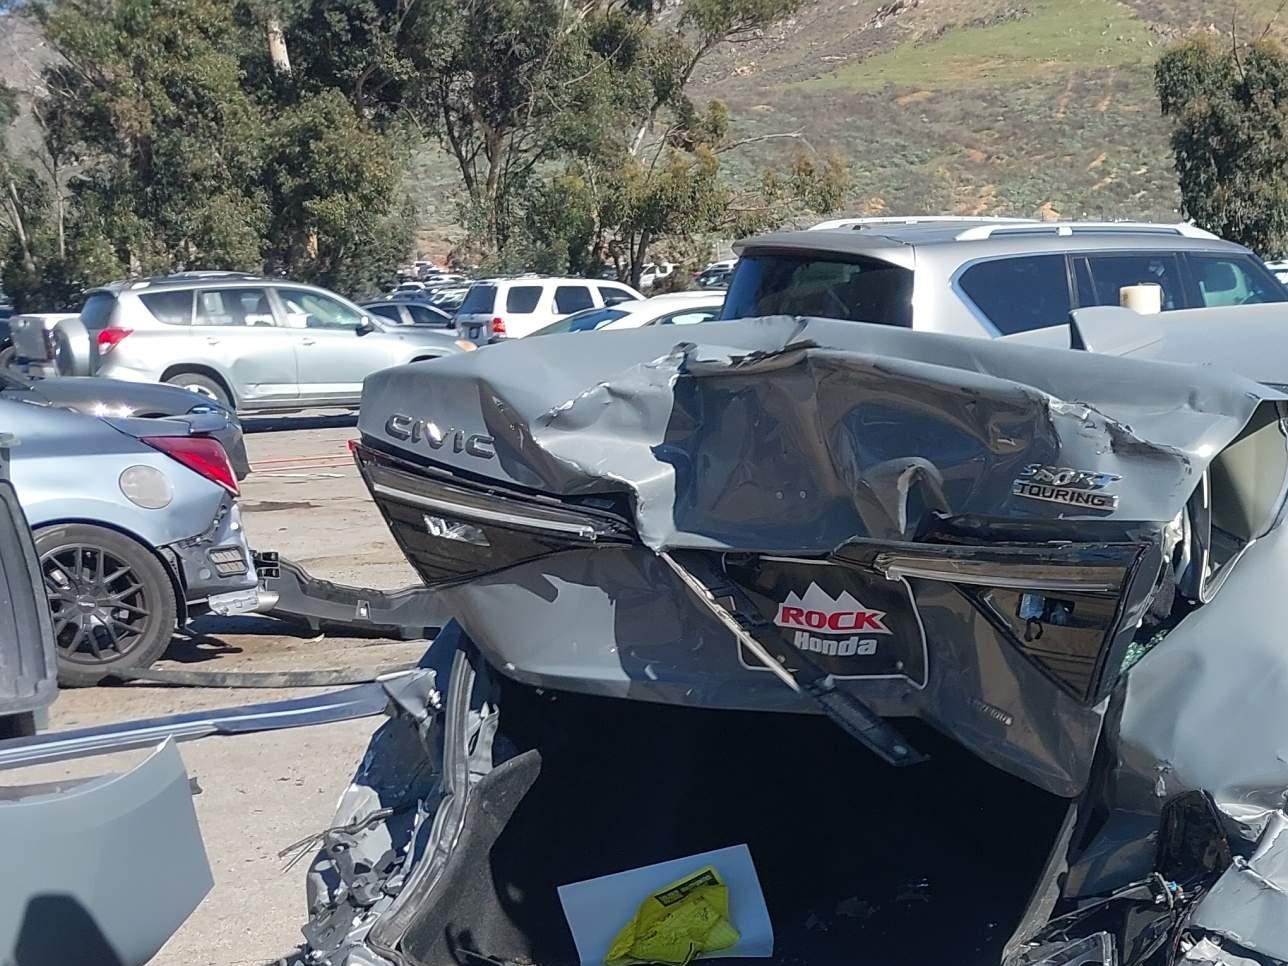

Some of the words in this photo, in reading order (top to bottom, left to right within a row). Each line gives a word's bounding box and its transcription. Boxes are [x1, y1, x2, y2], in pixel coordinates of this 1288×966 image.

[385, 413, 495, 459] CIVIC
[1018, 482, 1106, 506] TOURING
[781, 606, 883, 630] ROCK
[794, 630, 878, 656] Honda
